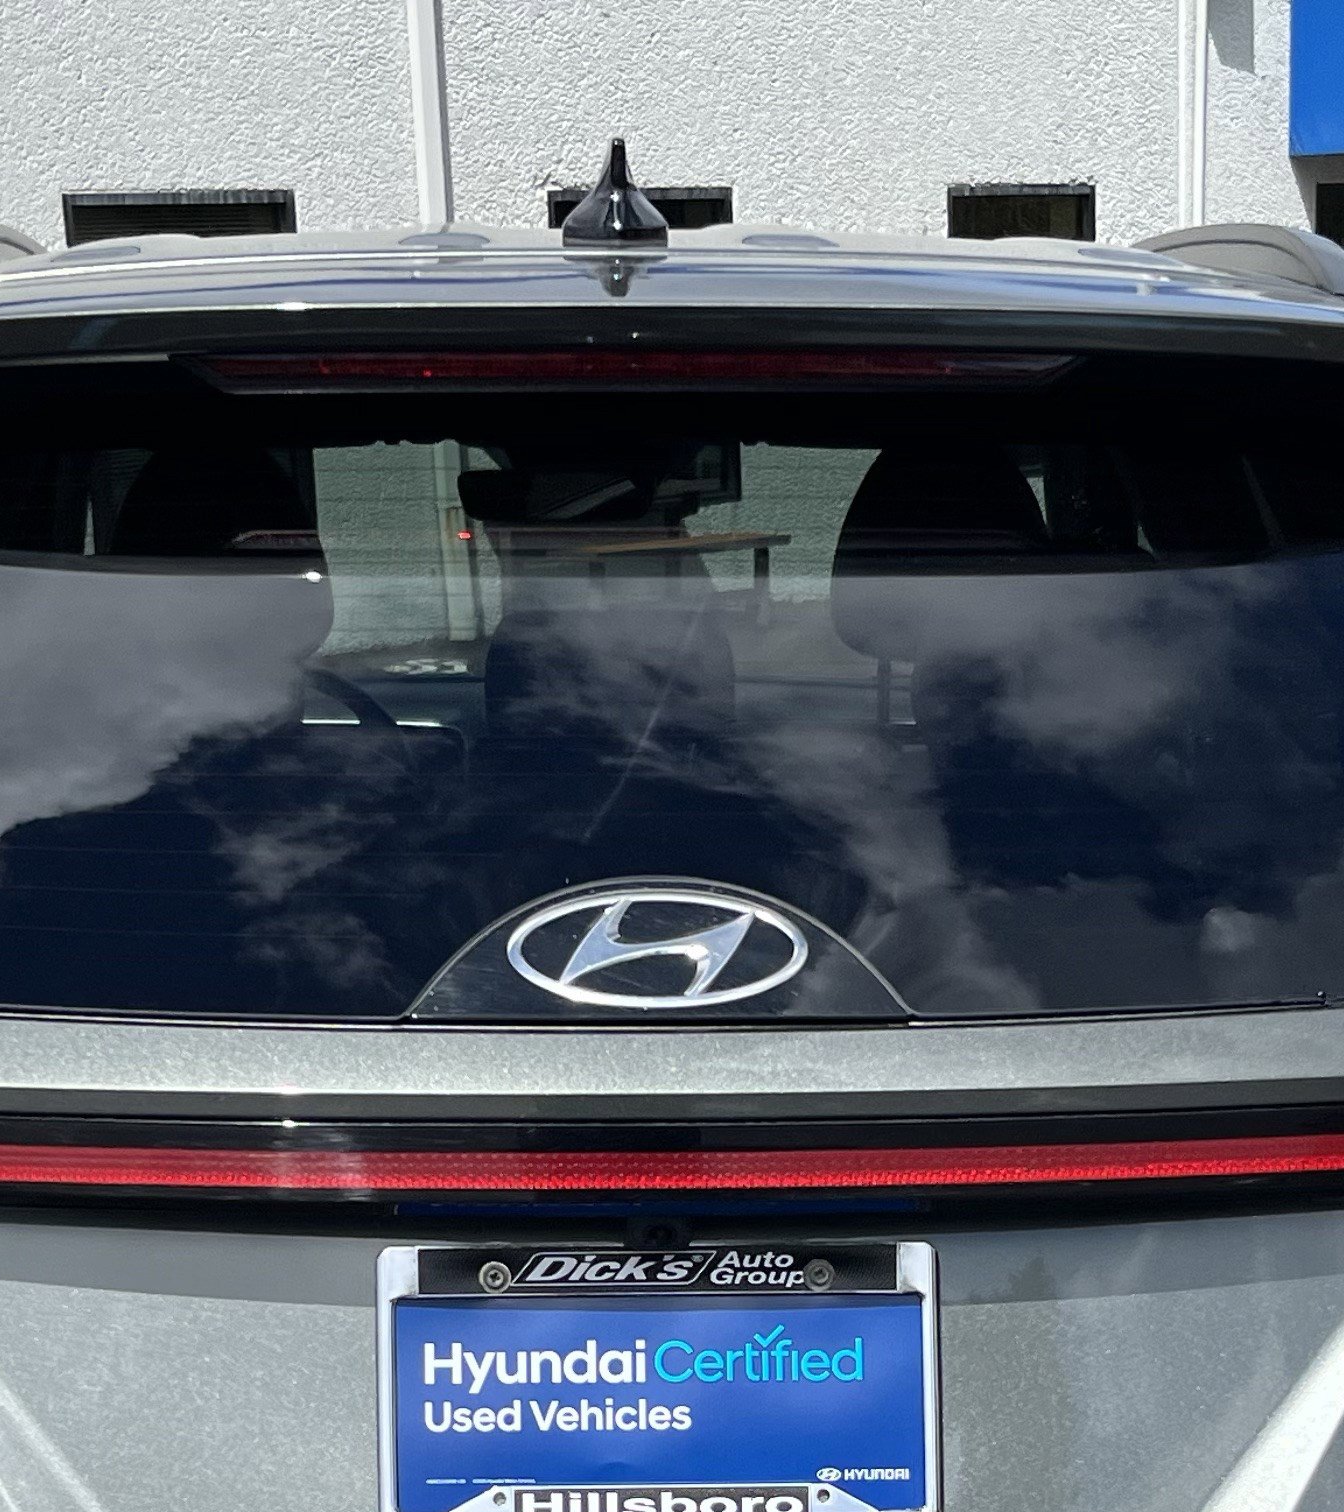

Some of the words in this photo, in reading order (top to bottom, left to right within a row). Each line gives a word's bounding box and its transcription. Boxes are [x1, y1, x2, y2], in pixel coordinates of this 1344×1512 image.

[525, 1254, 692, 1282] Dick's
[717, 1250, 794, 1268] Auto
[709, 1267, 805, 1288] Group
[423, 1339, 647, 1393] Hyundai
[654, 1325, 865, 1384] Certified
[423, 1400, 522, 1433] Used
[529, 1398, 693, 1432] Vehicles
[843, 1468, 911, 1481] HYUNDAI
